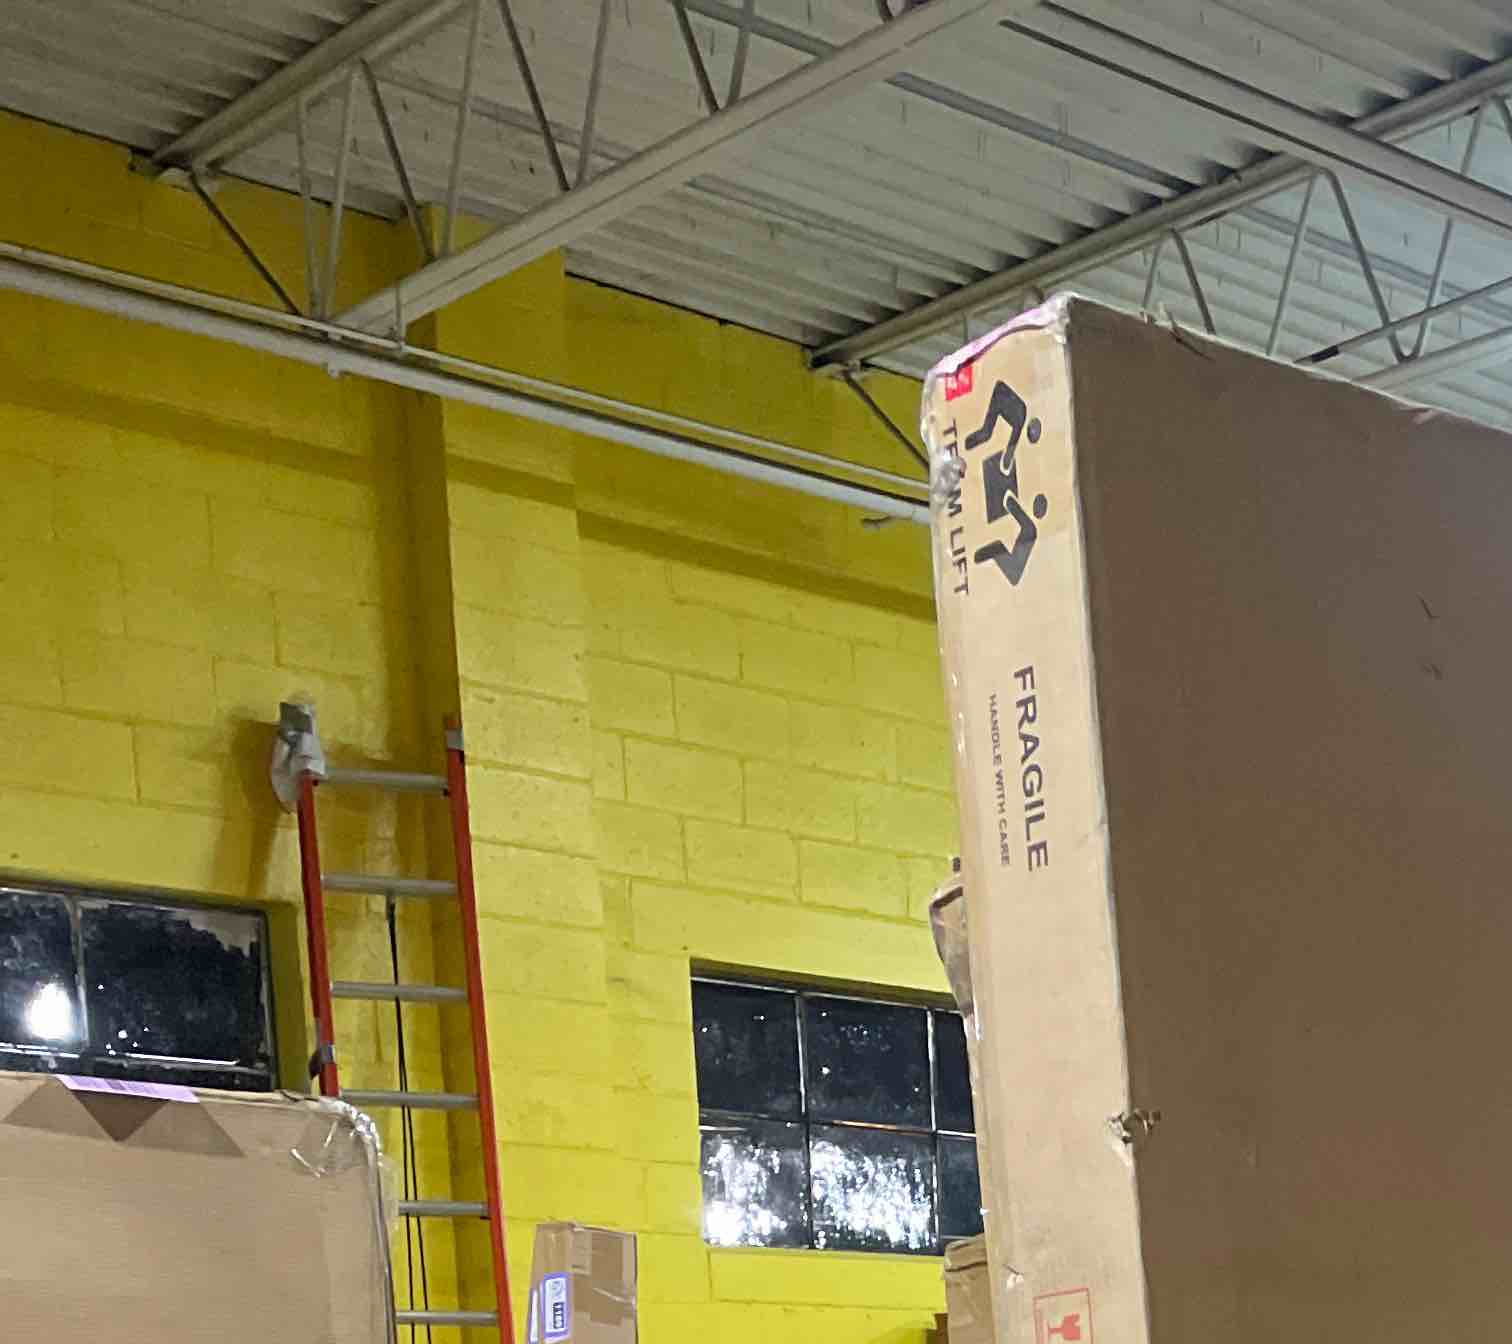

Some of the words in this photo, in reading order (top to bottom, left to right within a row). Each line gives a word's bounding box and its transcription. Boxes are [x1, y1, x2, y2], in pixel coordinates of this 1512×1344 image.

[942, 418, 963, 519] TEM
[948, 526, 970, 597] LIFT
[989, 694, 1002, 767] HANDLE
[995, 769, 1006, 814] WITH
[1014, 664, 1049, 872] FRAGILE
[998, 818, 1010, 865] CARE
